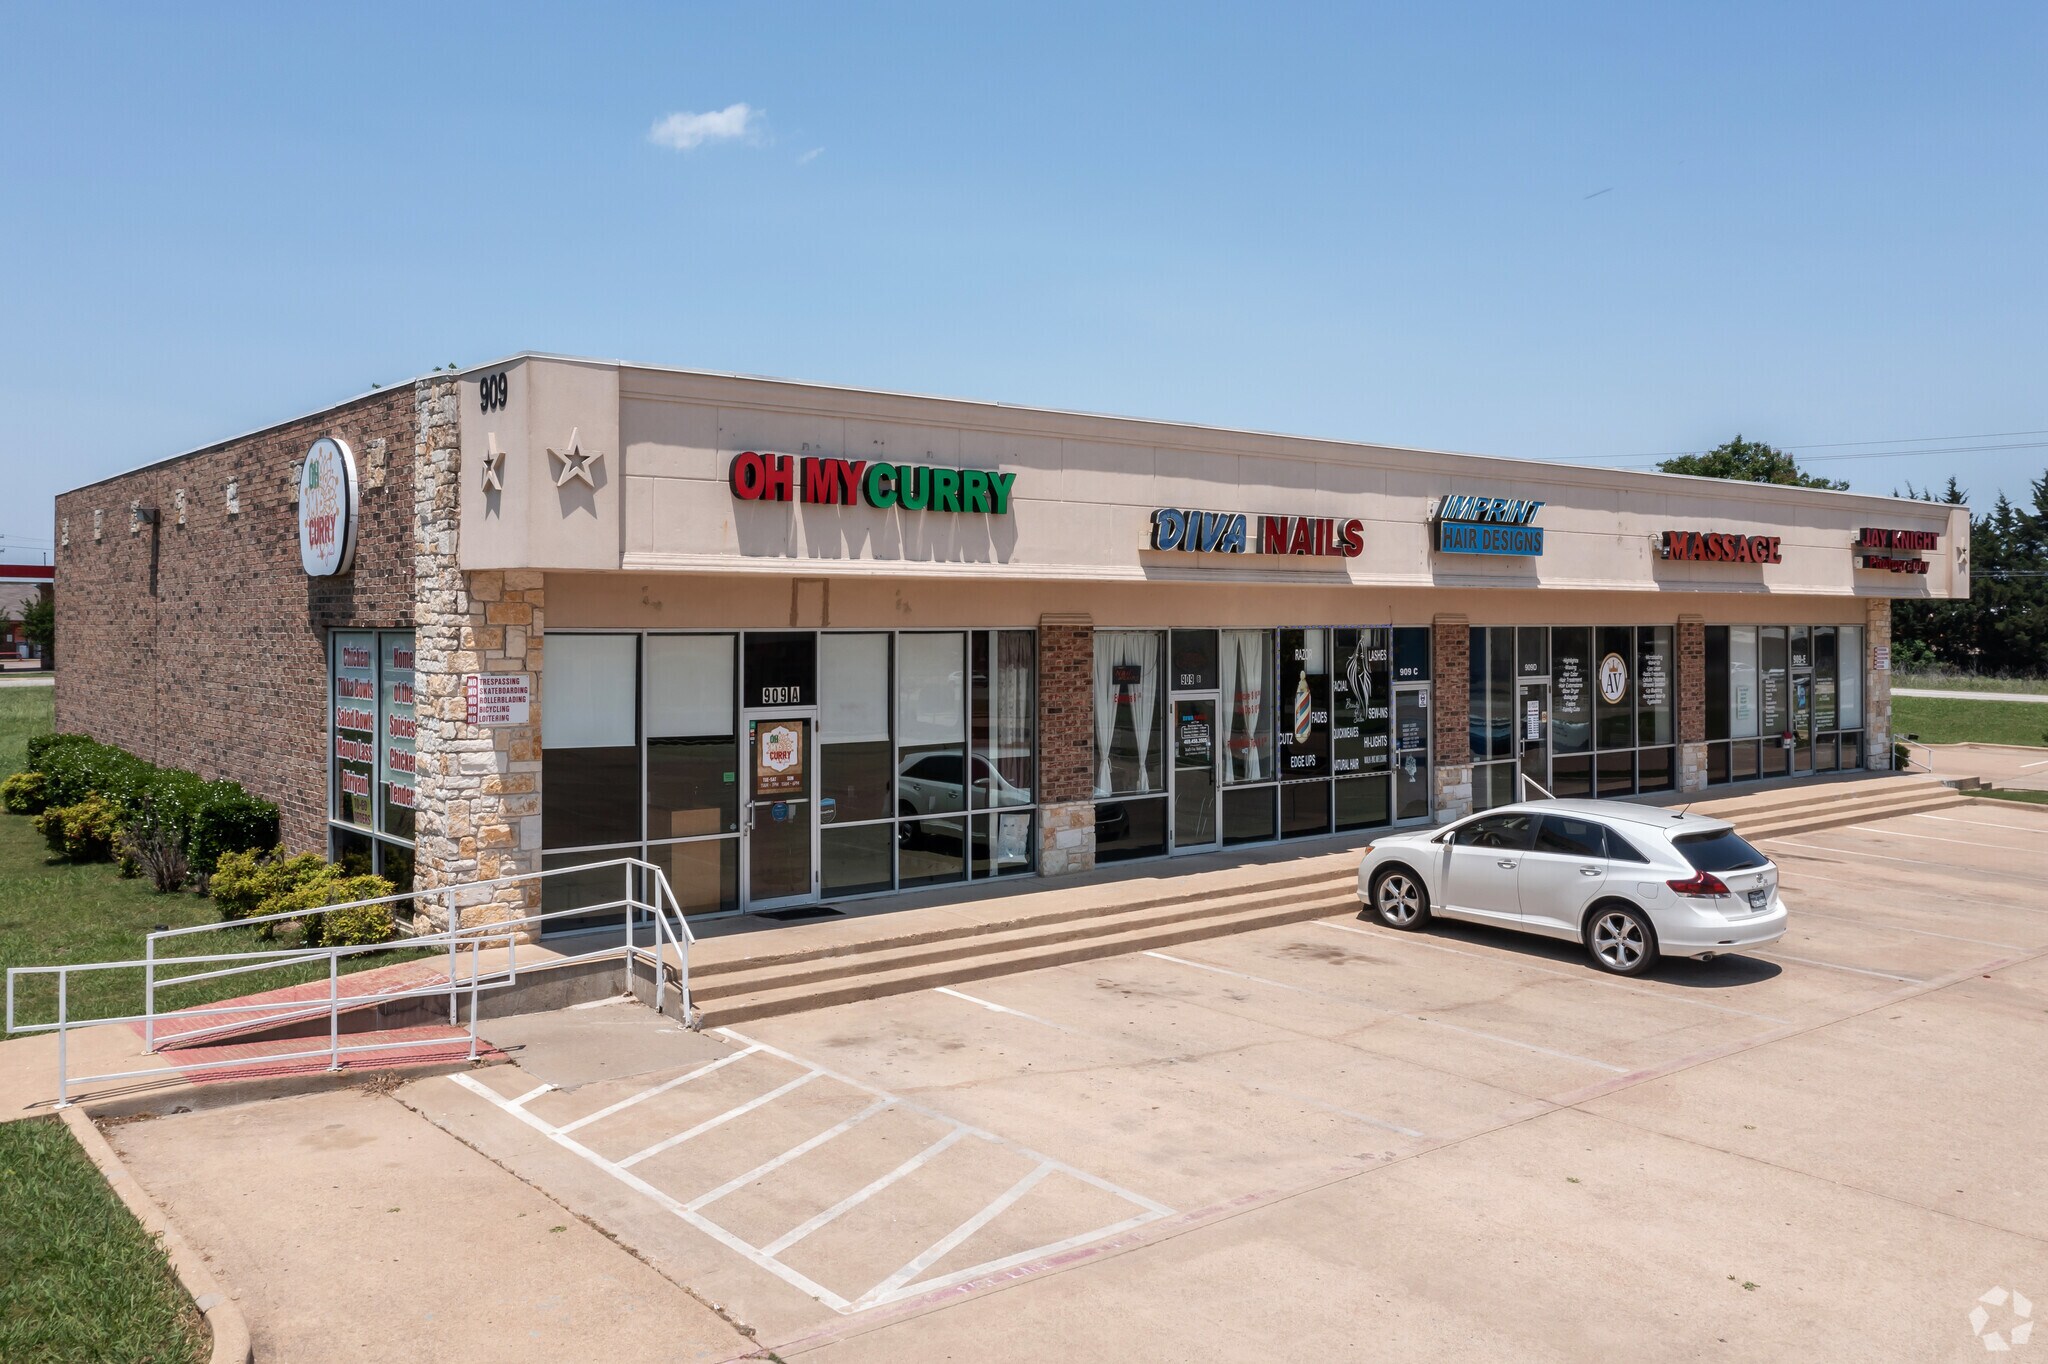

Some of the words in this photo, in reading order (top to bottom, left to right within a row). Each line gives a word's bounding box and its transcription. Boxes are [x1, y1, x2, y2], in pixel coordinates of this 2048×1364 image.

[480, 372, 507, 412] 909
[309, 459, 319, 489] OH
[729, 451, 793, 502] OH
[800, 457, 867, 506] MY
[863, 463, 1017, 514] CURRY
[1441, 495, 1546, 524] IMPRINT
[309, 514, 336, 546] CURRY
[1151, 508, 1247, 553] DIVA
[1257, 516, 1364, 557] NAILS
[1443, 527, 1477, 549] HAIR
[1482, 529, 1541, 553] DESIGNS
[1862, 528, 1888, 548] JAY
[1891, 530, 1939, 550] KNIGHT
[1663, 531, 1781, 564] MASSAGE
[343, 647, 370, 668] Chicken
[393, 647, 414, 670] Home
[1368, 649, 1387, 662] LASHES
[468, 678, 477, 686] NO
[1181, 674, 1194, 685] 909
[1400, 667, 1412, 676] 909
[1413, 667, 1418, 675] C
[338, 677, 354, 697] Tikka
[354, 678, 373, 700] Bowls
[393, 681, 401, 704] of
[402, 682, 414, 705] the
[468, 687, 477, 696] NO
[479, 686, 528, 695] SKATEBOARDING
[1605, 672, 1622, 694] AV
[468, 696, 477, 705] NO
[479, 696, 527, 704] ROLLERBLADING
[763, 687, 786, 704] 909
[792, 687, 799, 702] A
[337, 706, 354, 729] Salad
[355, 707, 373, 732] Bowls
[468, 706, 477, 714] NO
[468, 715, 477, 723] NO
[479, 714, 510, 722] LOITERING
[1312, 712, 1328, 724] FADES
[1368, 707, 1388, 719] SEW-INS
[389, 713, 416, 739] Spicies
[1280, 732, 1294, 745] CUTZ
[1364, 736, 1388, 748] HI-LIGHTS
[337, 736, 357, 762] Mango
[358, 740, 373, 764] Lass
[770, 751, 792, 760] CURRY
[1291, 756, 1304, 768] EDGE
[1305, 754, 1316, 767] UPS
